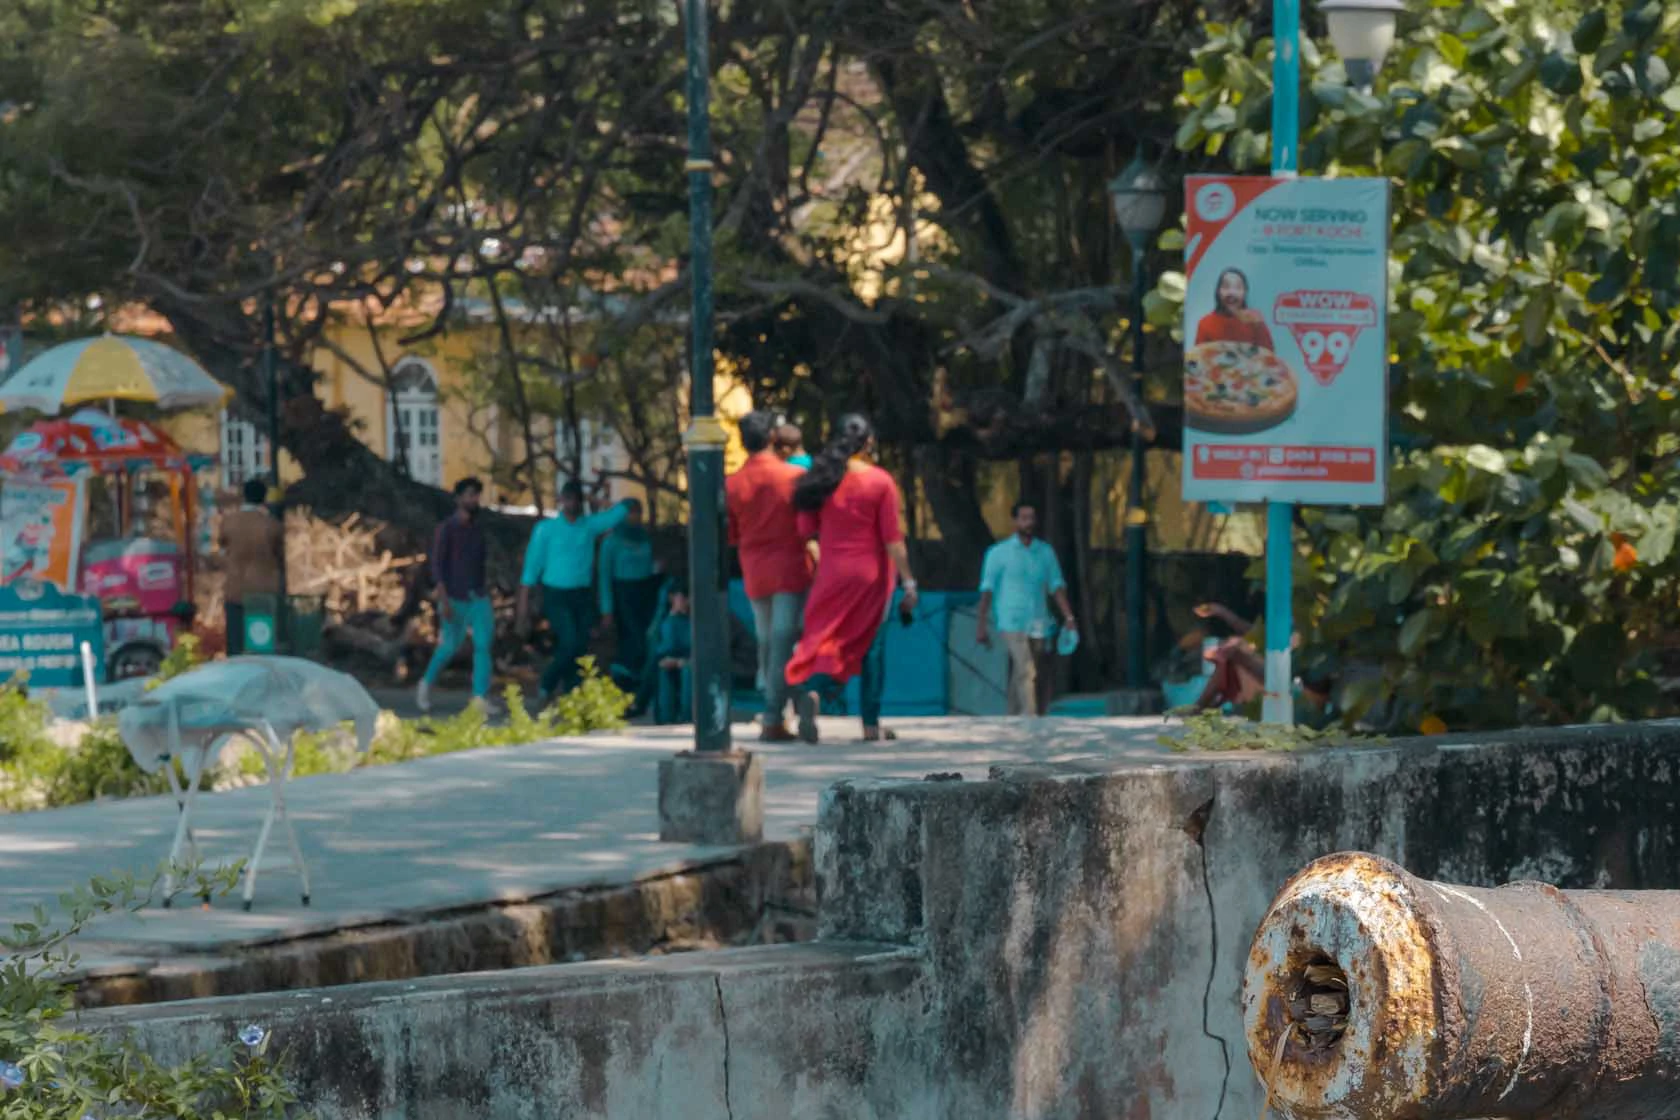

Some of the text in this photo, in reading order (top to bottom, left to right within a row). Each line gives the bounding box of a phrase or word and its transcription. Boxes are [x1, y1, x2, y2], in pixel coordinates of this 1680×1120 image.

[1255, 208, 1368, 223] NOW SERVING
[1299, 293, 1353, 309] WOW
[1302, 330, 1349, 365] 99
